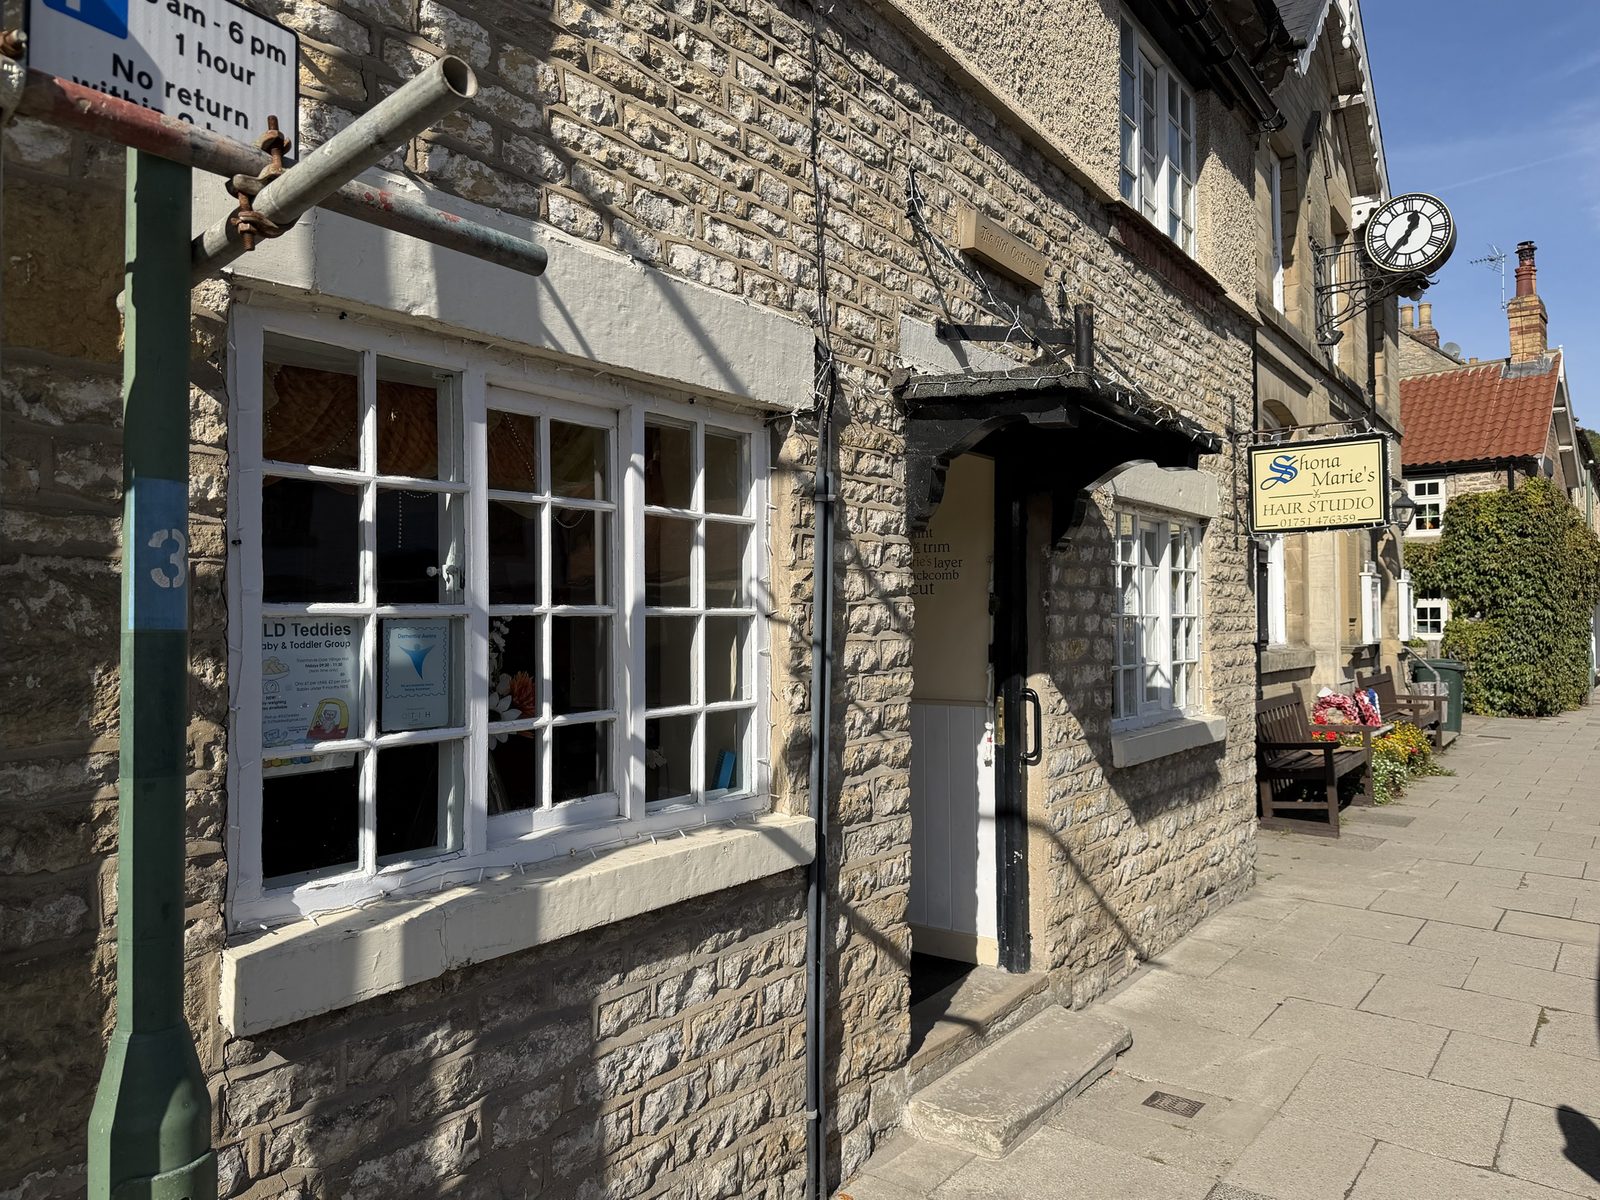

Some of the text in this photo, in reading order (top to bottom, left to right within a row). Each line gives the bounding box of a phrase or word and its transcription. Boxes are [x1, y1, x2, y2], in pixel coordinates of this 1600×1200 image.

[175, 32, 256, 86] 1 hour
[112, 52, 153, 90] No
[165, 80, 249, 130] return
[1011, 246, 1041, 276] Cottage
[1260, 453, 1342, 490] Shona
[1312, 465, 1376, 487] Marie's
[1263, 496, 1375, 516] HAIR STUDIO
[1280, 514, 1356, 528] 01751 476359
[147, 528, 186, 588] 3
[923, 542, 951, 554] trim
[933, 557, 963, 571] layer
[291, 622, 352, 637] Teddies
[281, 641, 287, 650] &
[290, 640, 322, 649] Toddler
[324, 639, 351, 649] Group
